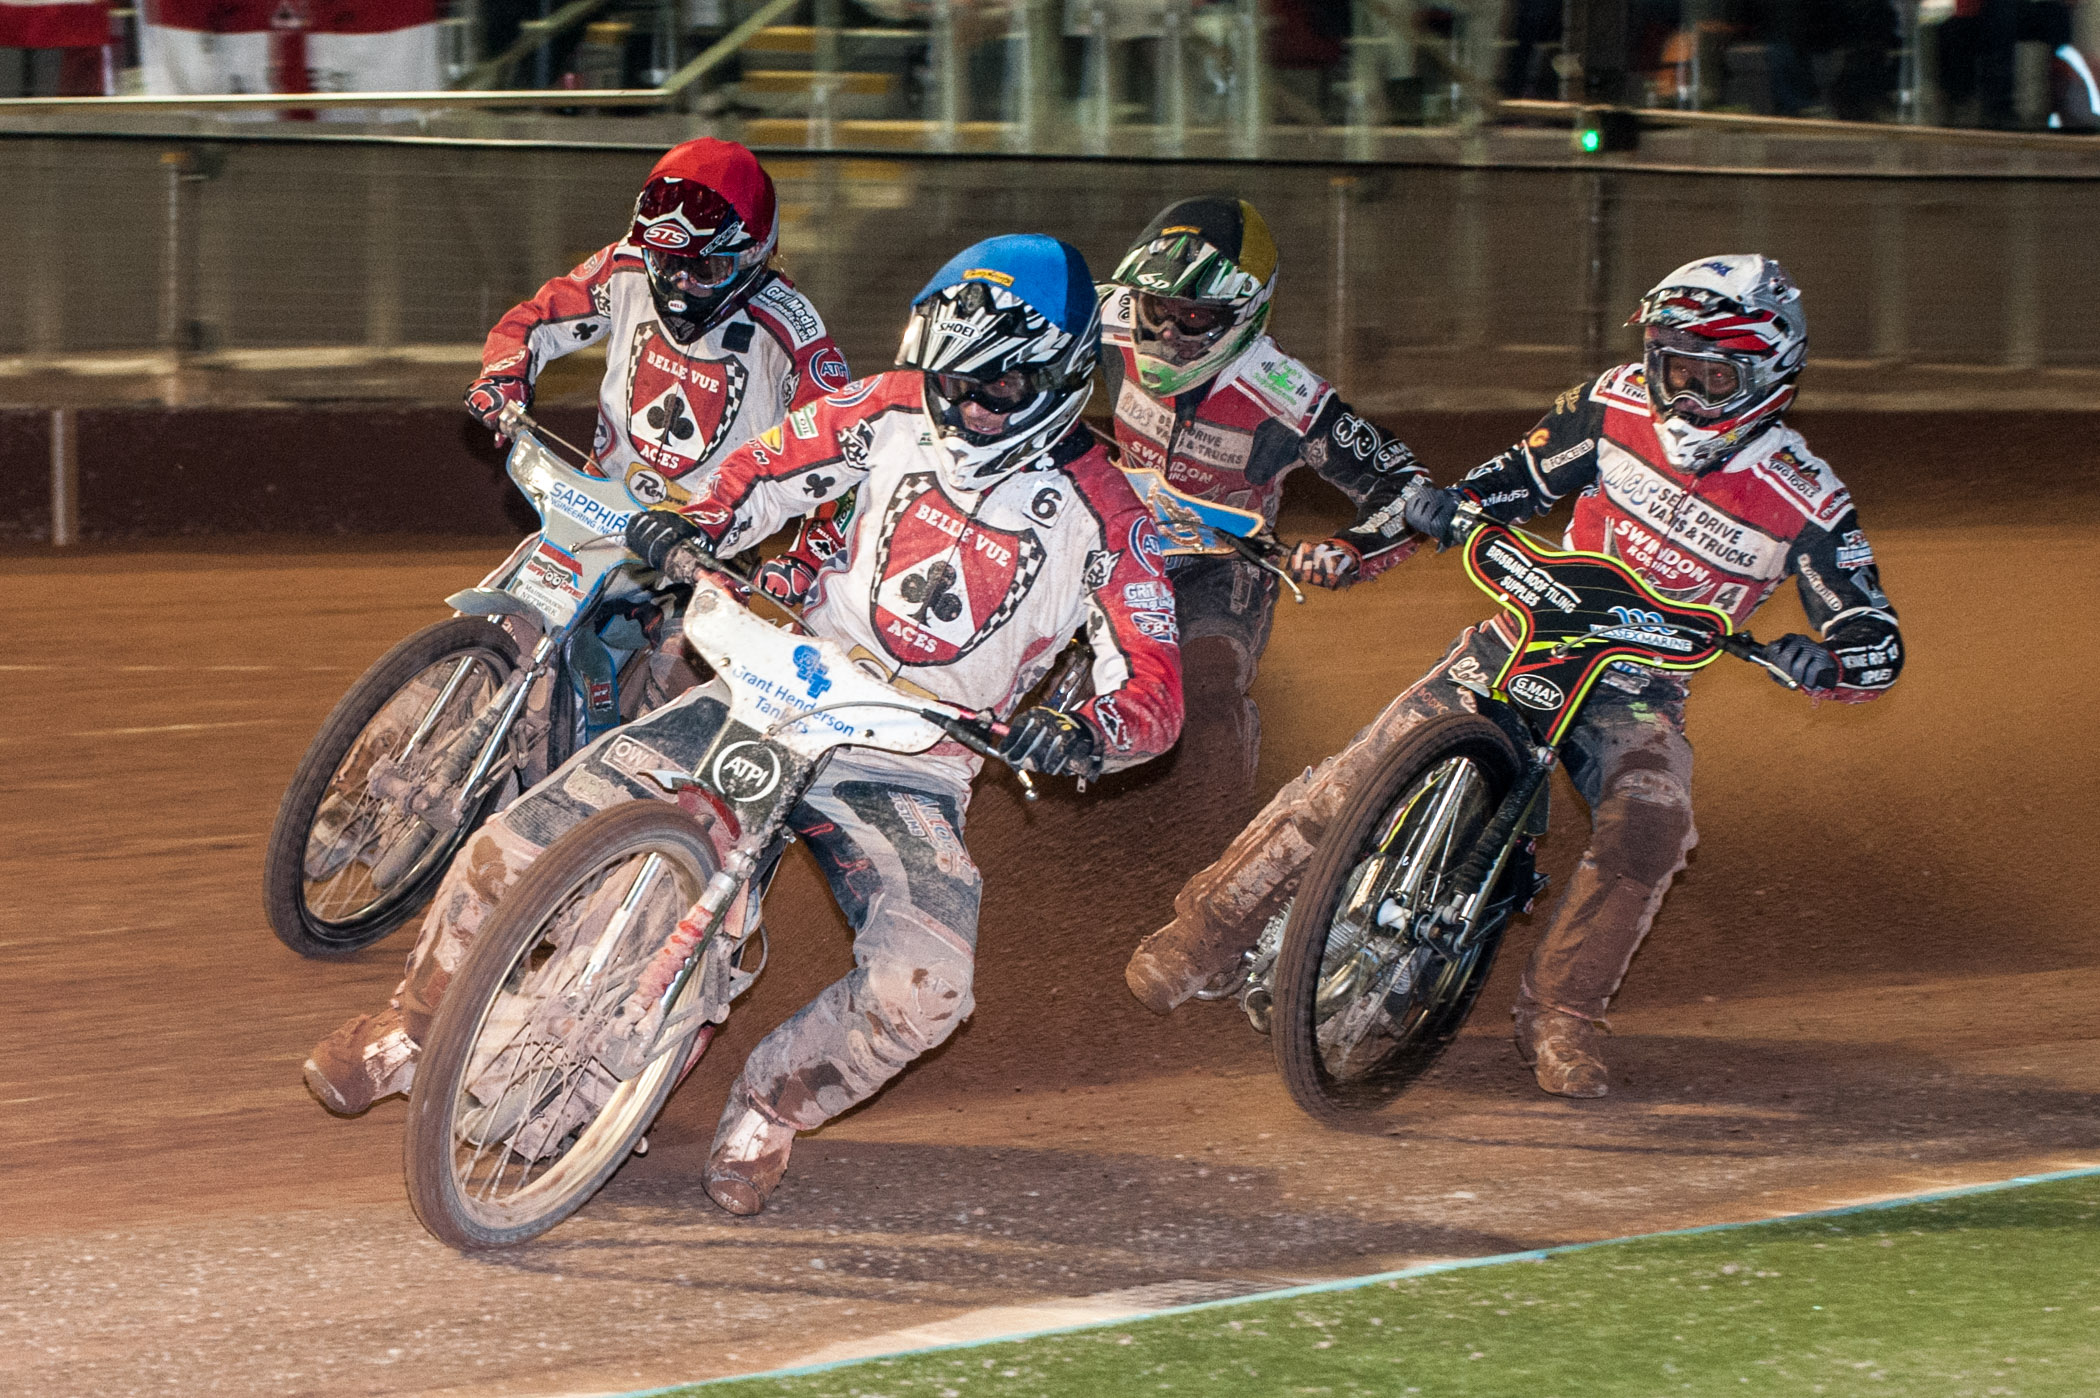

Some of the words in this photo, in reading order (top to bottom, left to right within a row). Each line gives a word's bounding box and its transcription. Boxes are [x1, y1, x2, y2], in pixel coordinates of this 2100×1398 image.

[645, 227, 688, 245] STS
[786, 296, 819, 338] Media
[938, 321, 976, 338] SHOEI
[646, 350, 689, 380] BELLE
[690, 369, 721, 393] VUE
[640, 444, 680, 470] ACES
[1198, 443, 1244, 466] TRUCKS
[549, 481, 630, 532] SAPPHIR
[1030, 487, 1063, 520] 6
[1657, 487, 1695, 516] SELF
[1694, 509, 1744, 546] DRIVE
[915, 503, 974, 544] BELLE
[974, 533, 1012, 568] VUE
[1614, 519, 1711, 583] SWINDON
[1684, 526, 1697, 542] &
[1696, 532, 1758, 568] TRUCKS
[1485, 544, 1529, 580] BRISBANE
[1522, 571, 1550, 593] ROOF
[1543, 586, 1577, 614] TILING
[1500, 575, 1541, 607] SUPPLIES
[1713, 585, 1744, 612] 4
[886, 619, 939, 654] ACES
[774, 685, 856, 737] Henderson
[722, 755, 770, 788] ATPI
